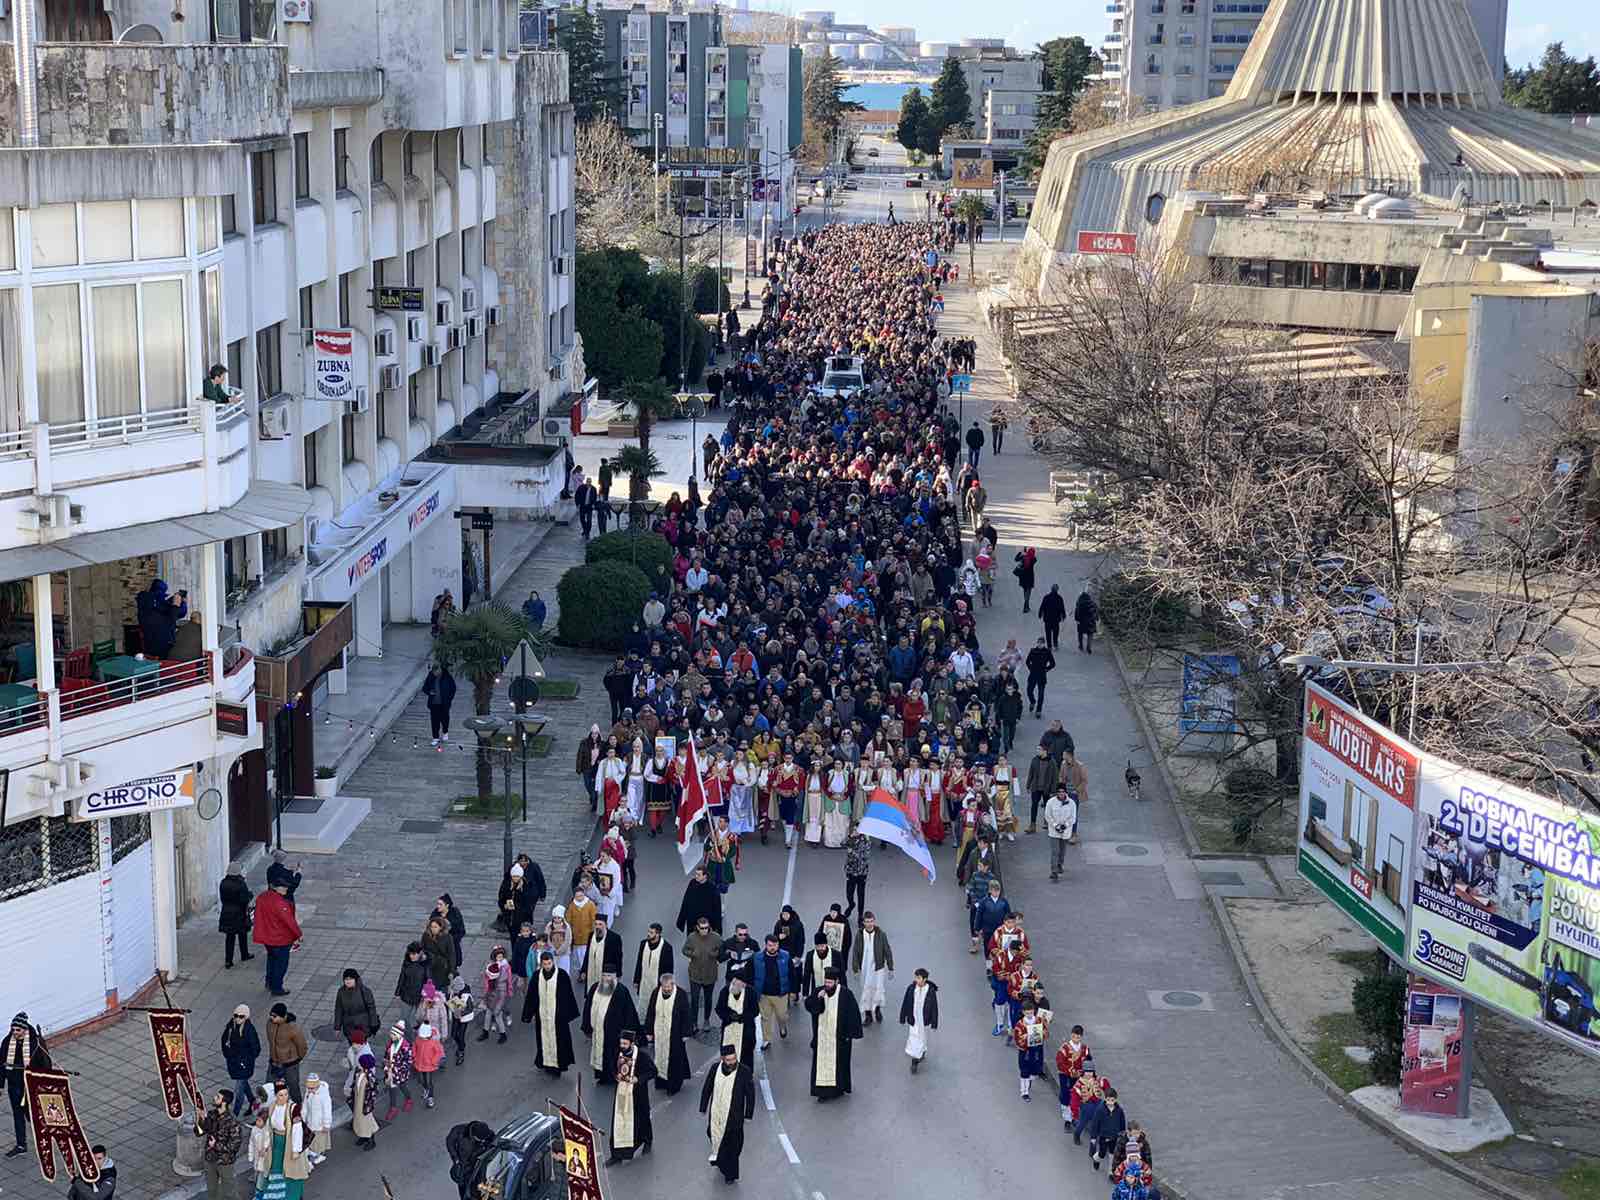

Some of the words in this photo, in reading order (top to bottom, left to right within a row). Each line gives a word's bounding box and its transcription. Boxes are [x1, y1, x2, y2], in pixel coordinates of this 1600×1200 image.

[317, 359, 350, 373] ZUBNA
[1329, 719, 1405, 795] MOBILARS
[87, 783, 176, 808] CHRONO
[1441, 801, 1462, 832] 2.
[1461, 787, 1529, 832] ROBNA
[1534, 815, 1591, 855] KUĆA
[1418, 886, 1456, 907] VRHUNSKI
[1456, 898, 1491, 922] KVALITET
[1418, 896, 1429, 907] PO
[1430, 900, 1472, 928] NAJBOLJOJ
[1473, 920, 1497, 937] CIJENI
[1551, 896, 1600, 931] PONU
[1415, 928, 1433, 961] 3
[1556, 921, 1600, 949] HYUND
[1432, 943, 1465, 966] GODINE
